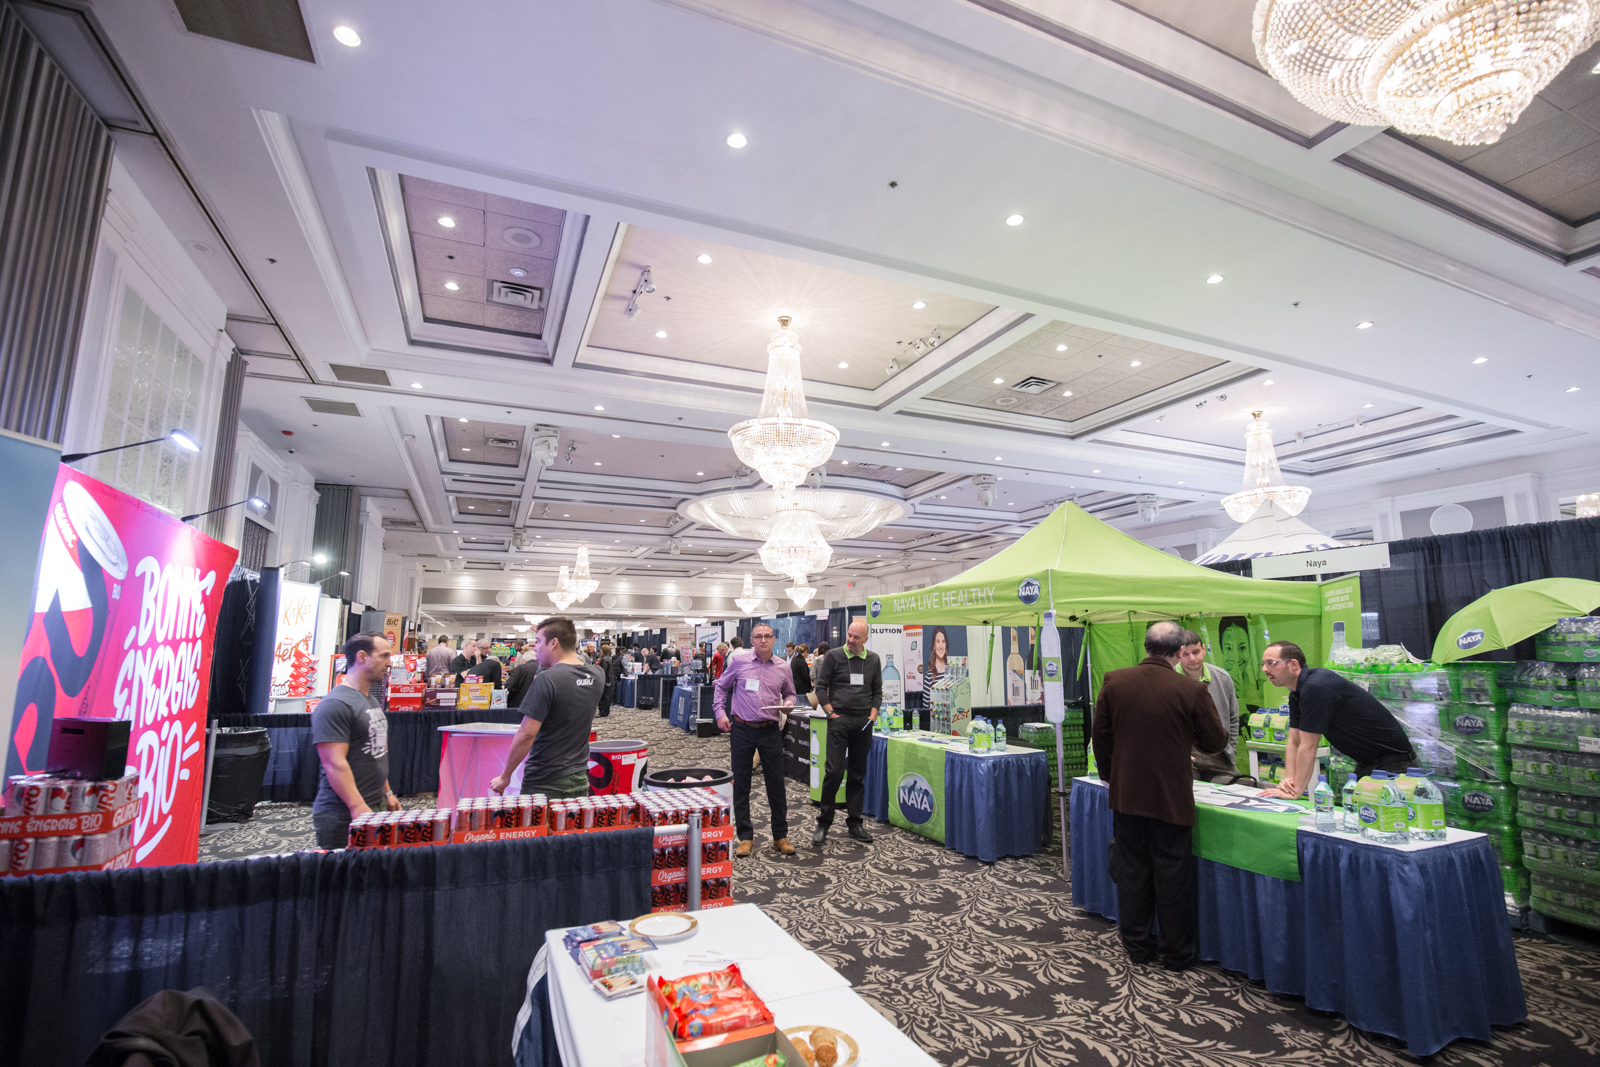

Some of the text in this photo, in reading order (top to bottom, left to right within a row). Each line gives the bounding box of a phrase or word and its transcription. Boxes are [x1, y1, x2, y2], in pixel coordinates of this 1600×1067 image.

[1306, 558, 1327, 568] Naya
[1018, 586, 1040, 597] NAYA
[135, 555, 216, 647] BONNE
[893, 586, 995, 613] NAYA LIVE HEALTHY
[1458, 633, 1482, 645] NAYA
[576, 678, 594, 687] GURU
[1455, 719, 1484, 728] NAYA
[900, 788, 931, 812] NAYA
[1464, 795, 1493, 807] NAYA
[112, 800, 140, 828] GURU
[1360, 808, 1377, 819] NAYA
[464, 830, 537, 843] Organic ENERGY
[701, 830, 724, 839] ERGY
[657, 866, 723, 882] Organic ERGY
